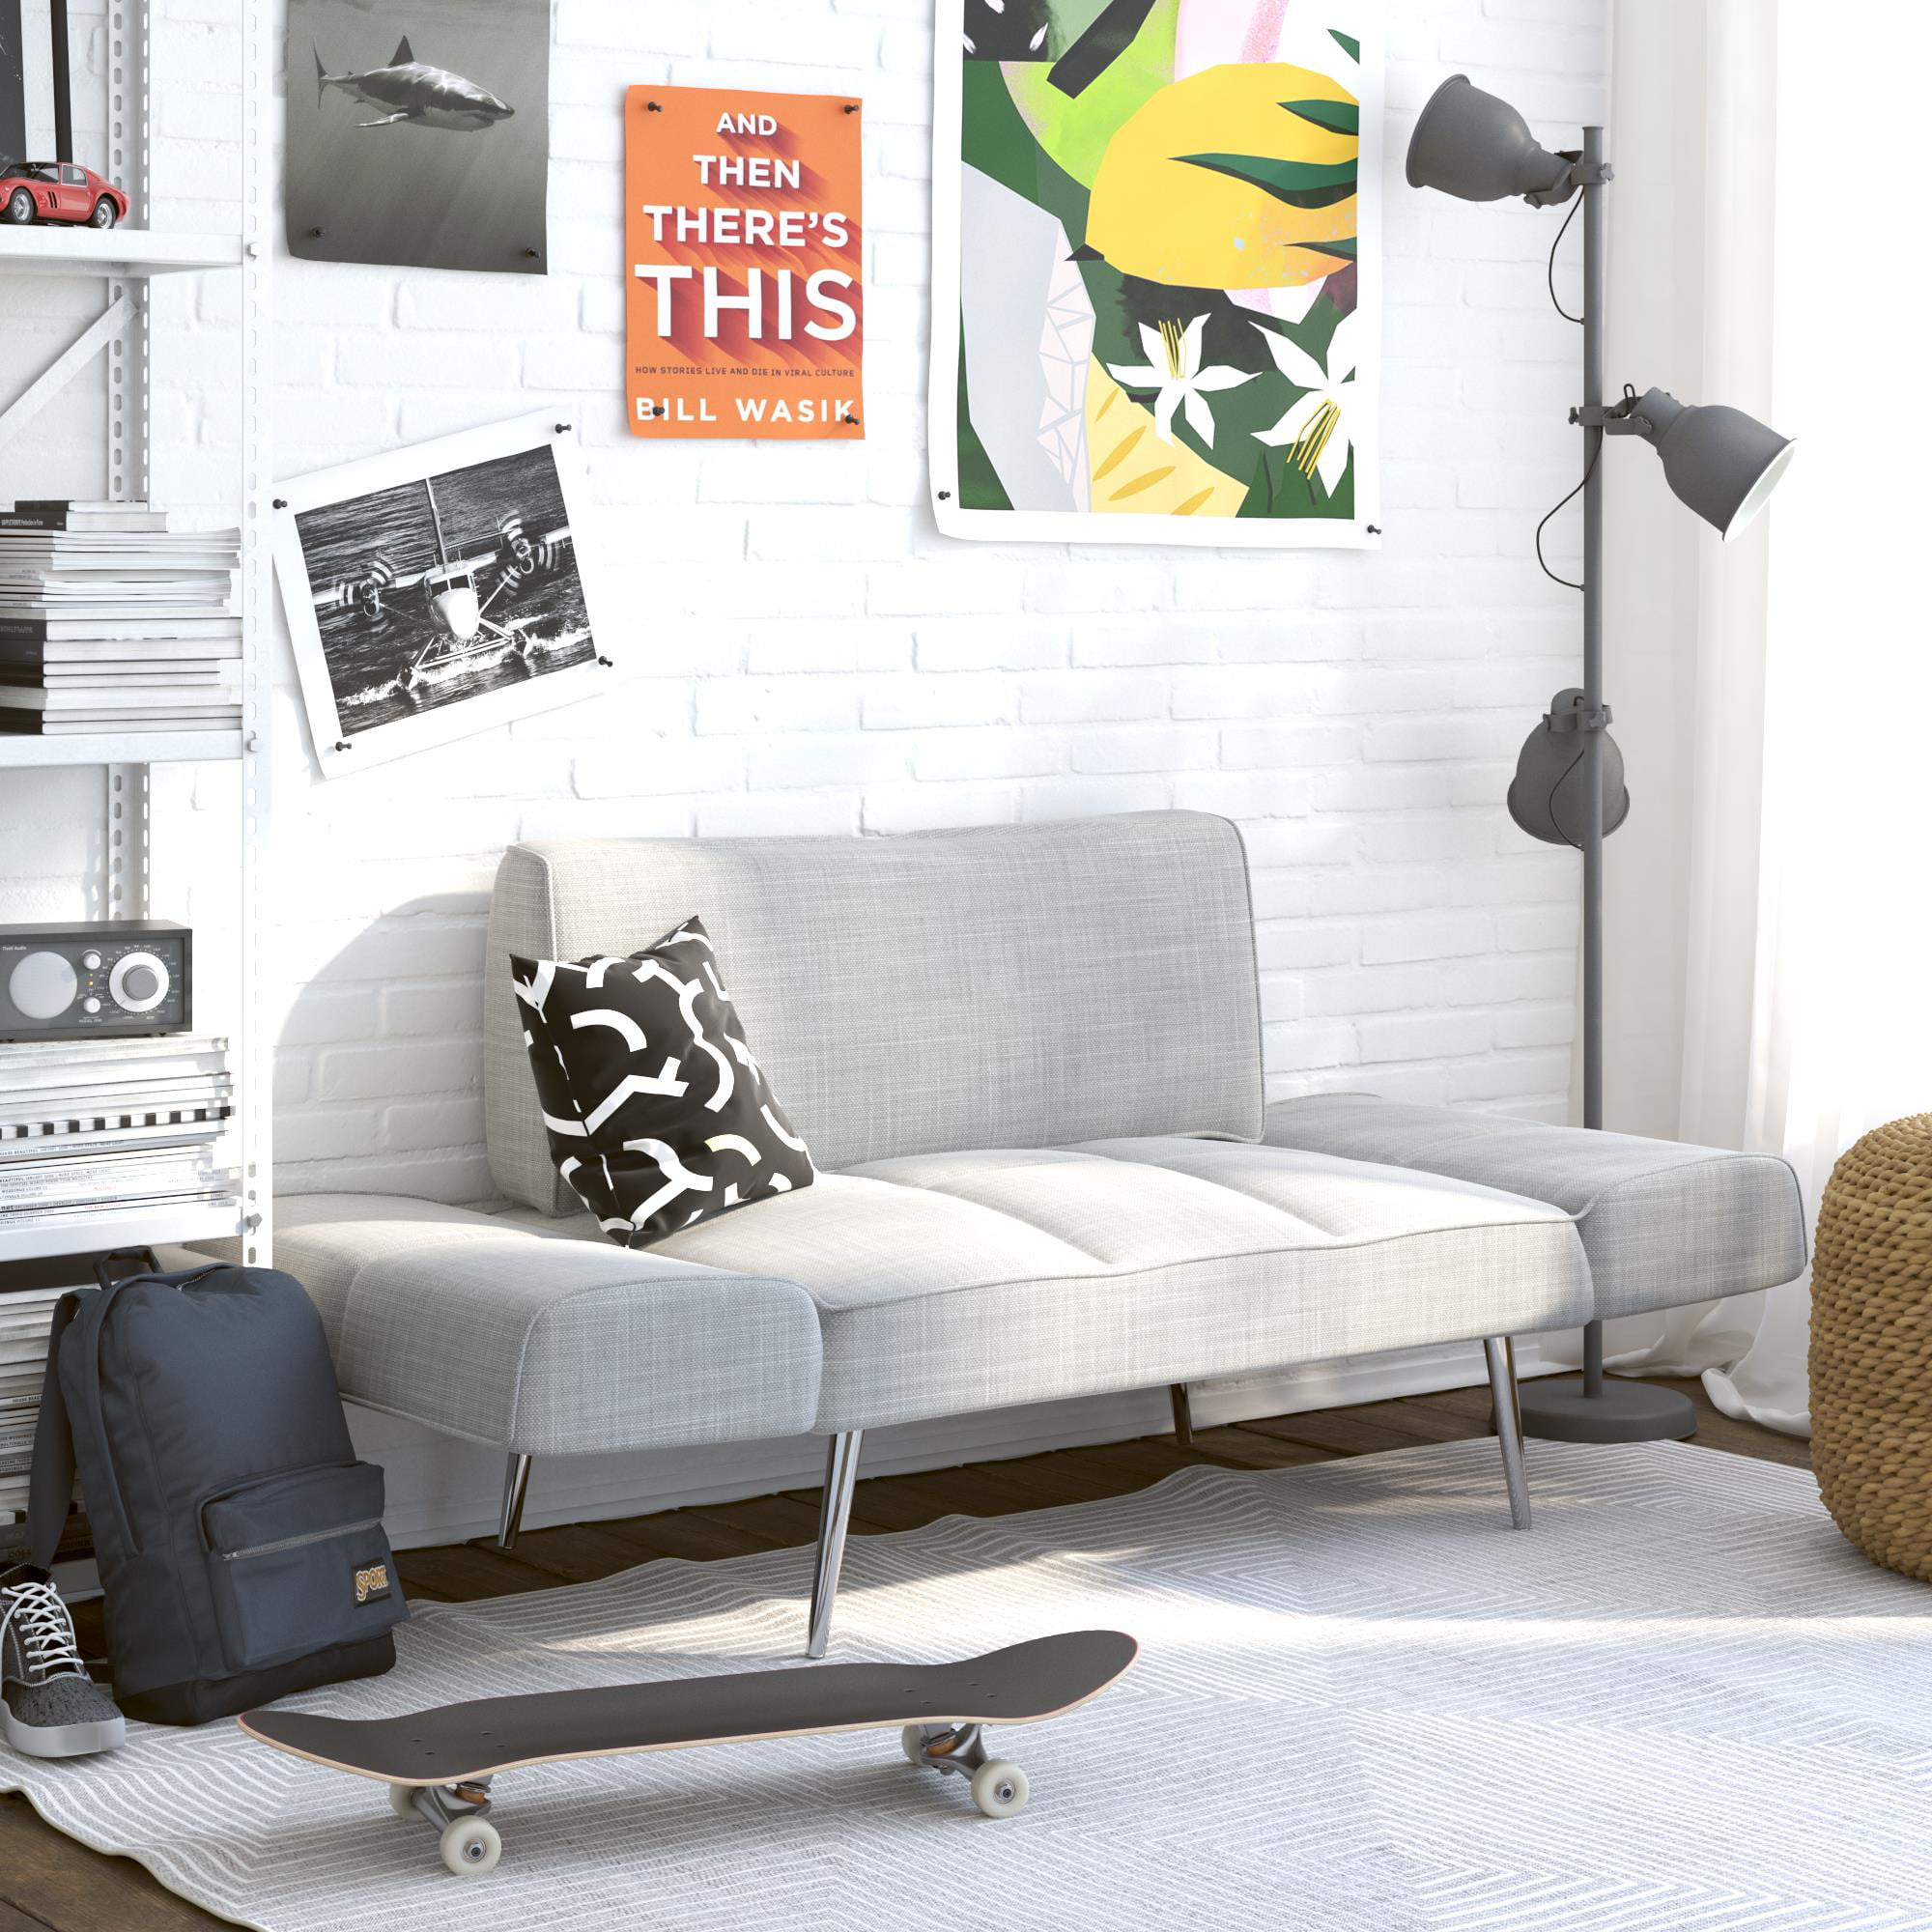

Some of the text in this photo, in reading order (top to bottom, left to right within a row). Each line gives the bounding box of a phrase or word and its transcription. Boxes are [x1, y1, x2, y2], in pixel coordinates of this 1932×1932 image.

[716, 112, 778, 136] AND
[693, 155, 800, 189] THEN
[642, 205, 848, 248] THERE'S
[634, 264, 857, 341] THIS
[660, 366, 702, 375] STORIES
[814, 369, 855, 378] CULTURE
[636, 397, 855, 422] BILL WASIK
